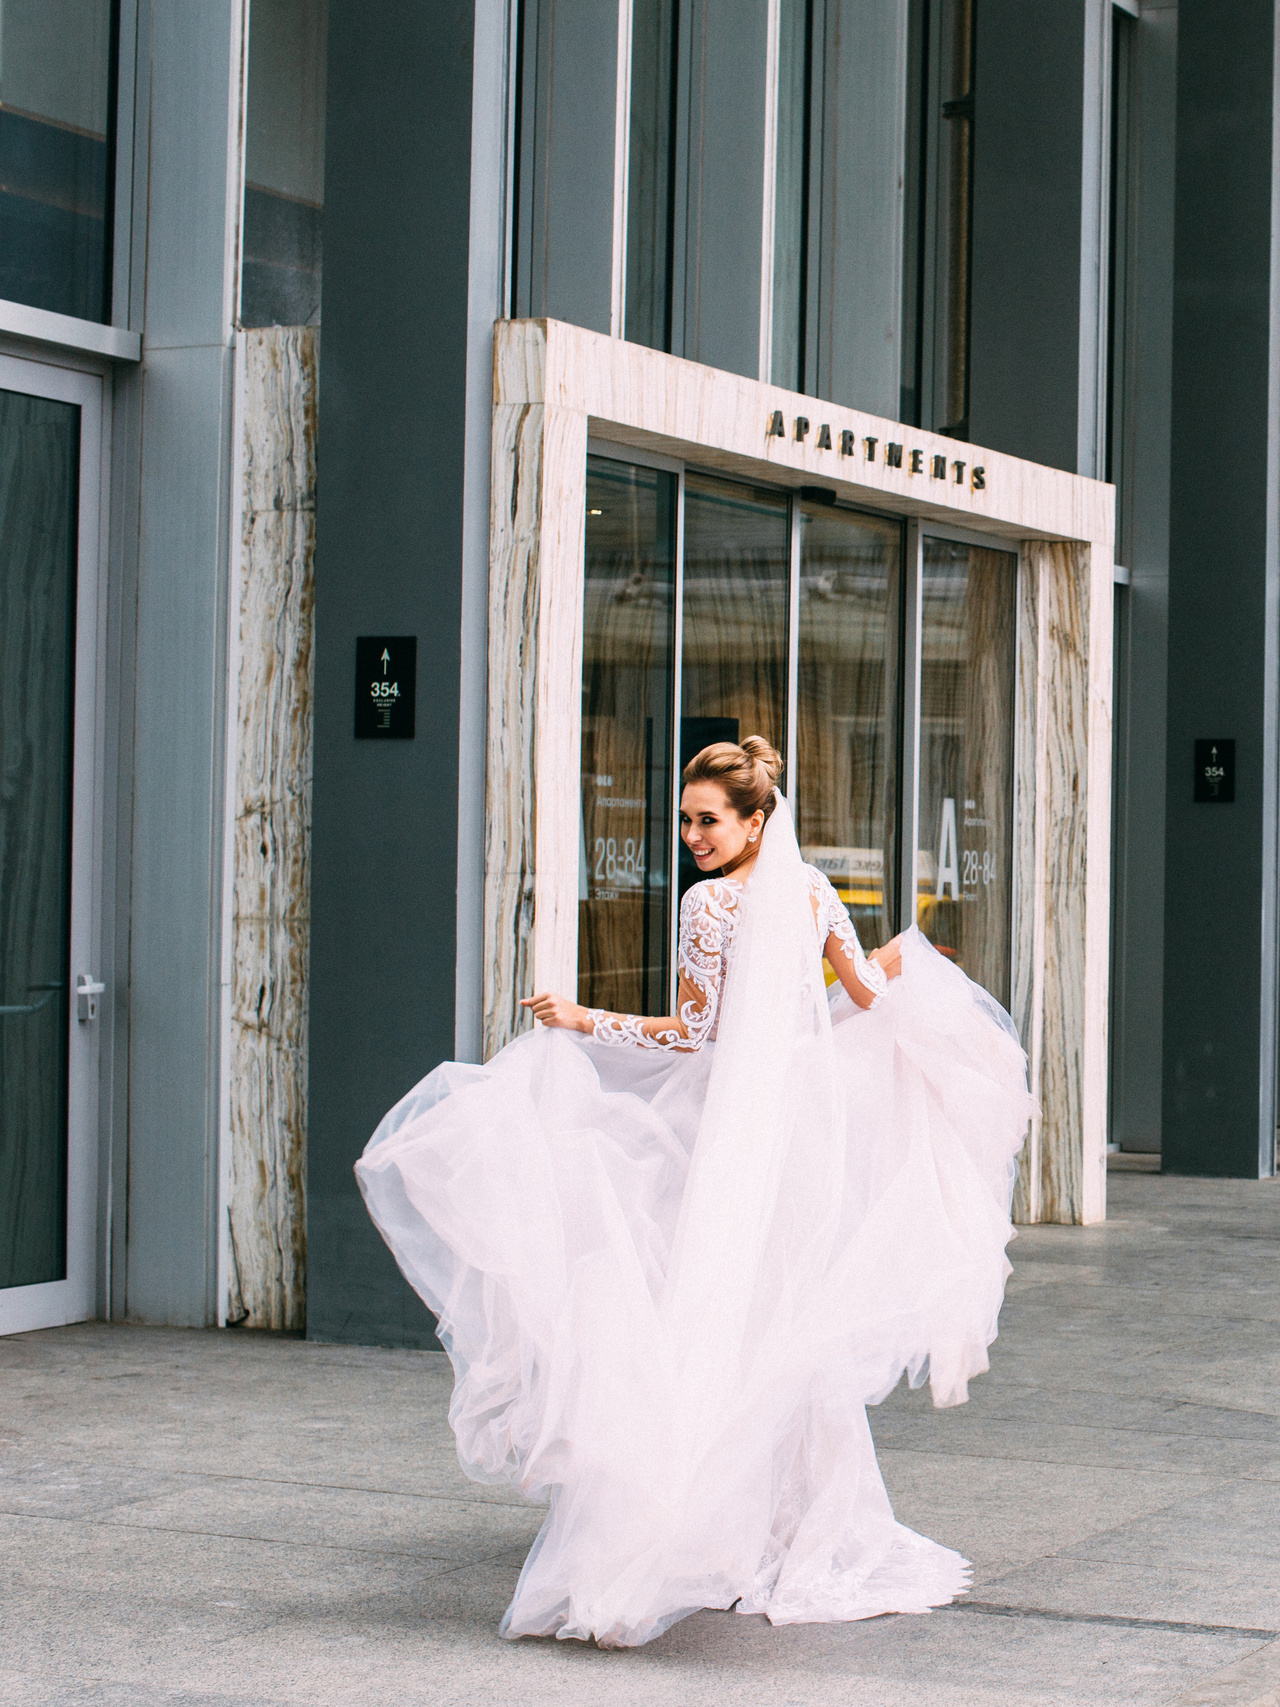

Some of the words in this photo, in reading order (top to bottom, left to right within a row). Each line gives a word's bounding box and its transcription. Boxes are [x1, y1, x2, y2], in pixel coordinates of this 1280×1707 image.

[766, 410, 986, 490] APARTMENTS
[1204, 766, 1225, 777] 354
[595, 837, 647, 881] 28-84
[936, 797, 960, 901] A
[963, 850, 997, 885] 28-84
